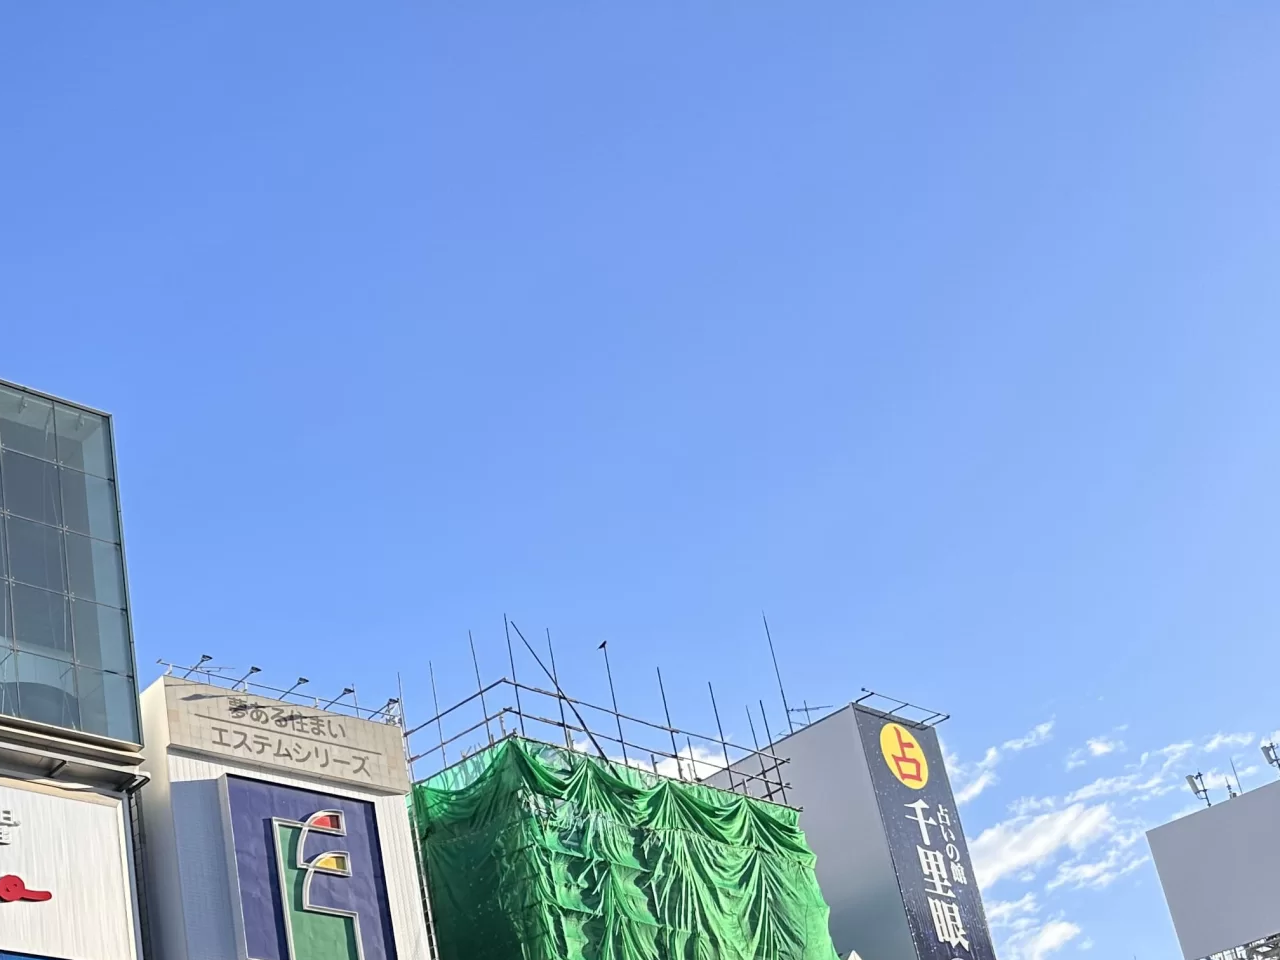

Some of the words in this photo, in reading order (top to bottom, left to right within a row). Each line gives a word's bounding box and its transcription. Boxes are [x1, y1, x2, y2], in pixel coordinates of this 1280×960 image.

[227, 697, 346, 740] 夢ある住まい
[211, 726, 371, 777] エステムシリーズ
[892, 726, 923, 783] 占
[937, 804, 967, 885] 占いの館
[904, 799, 969, 952] 千里眼
